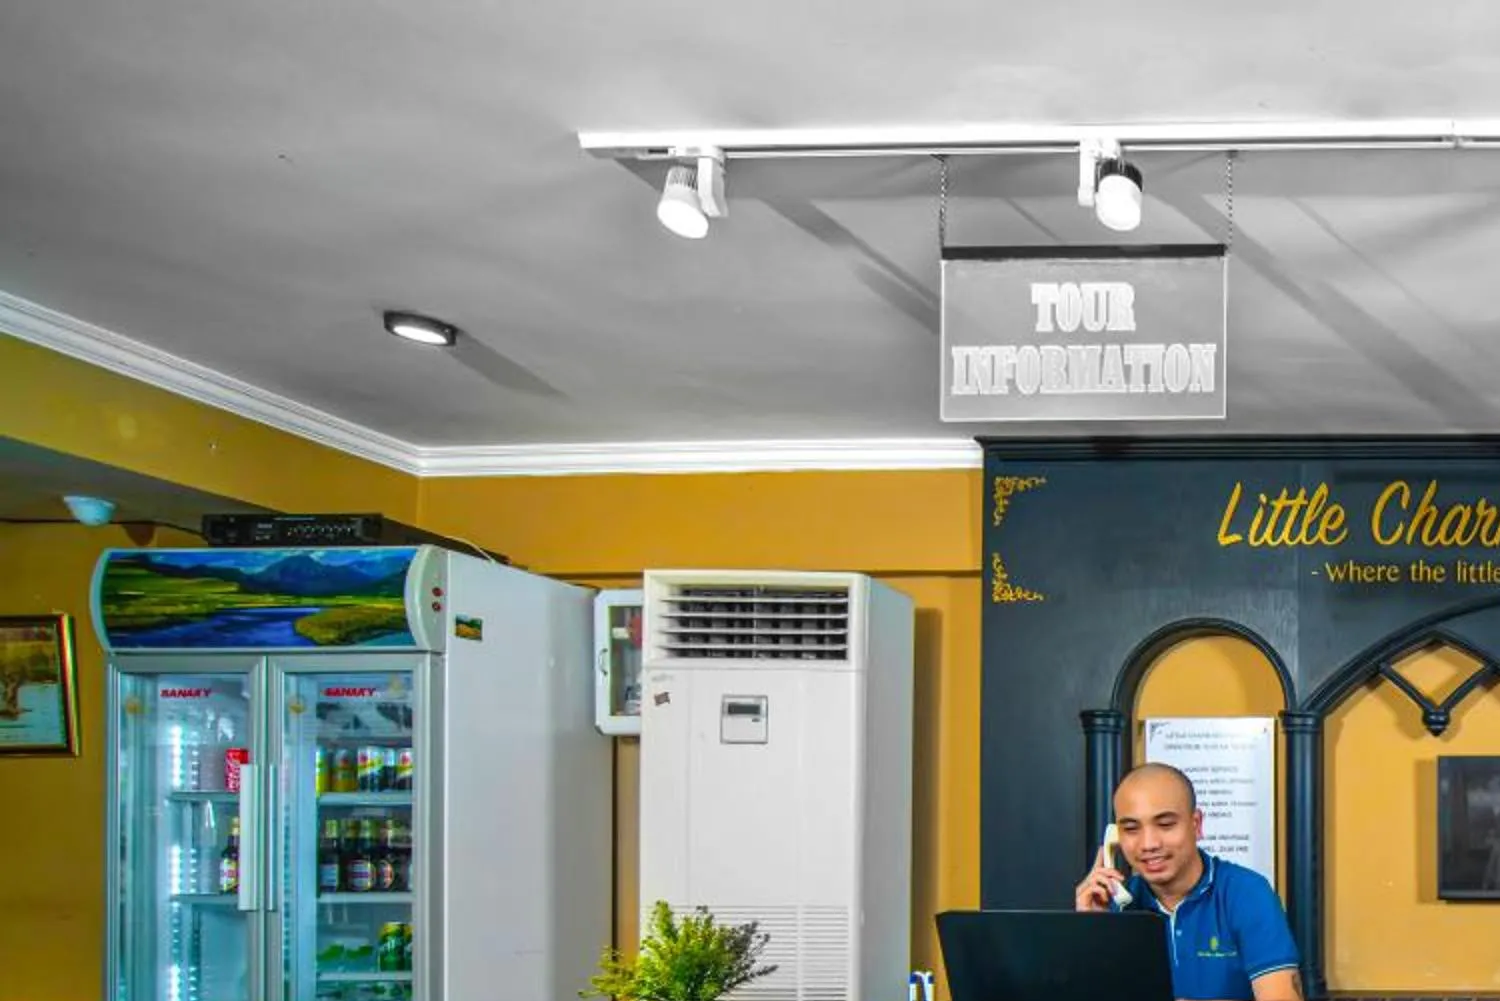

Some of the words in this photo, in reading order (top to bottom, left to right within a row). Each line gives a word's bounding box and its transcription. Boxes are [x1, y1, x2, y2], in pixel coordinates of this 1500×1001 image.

[1031, 281, 1136, 332] TOUR
[951, 343, 1217, 395] INFORMATION
[1217, 481, 1348, 547] Little
[1410, 560, 1446, 583] the
